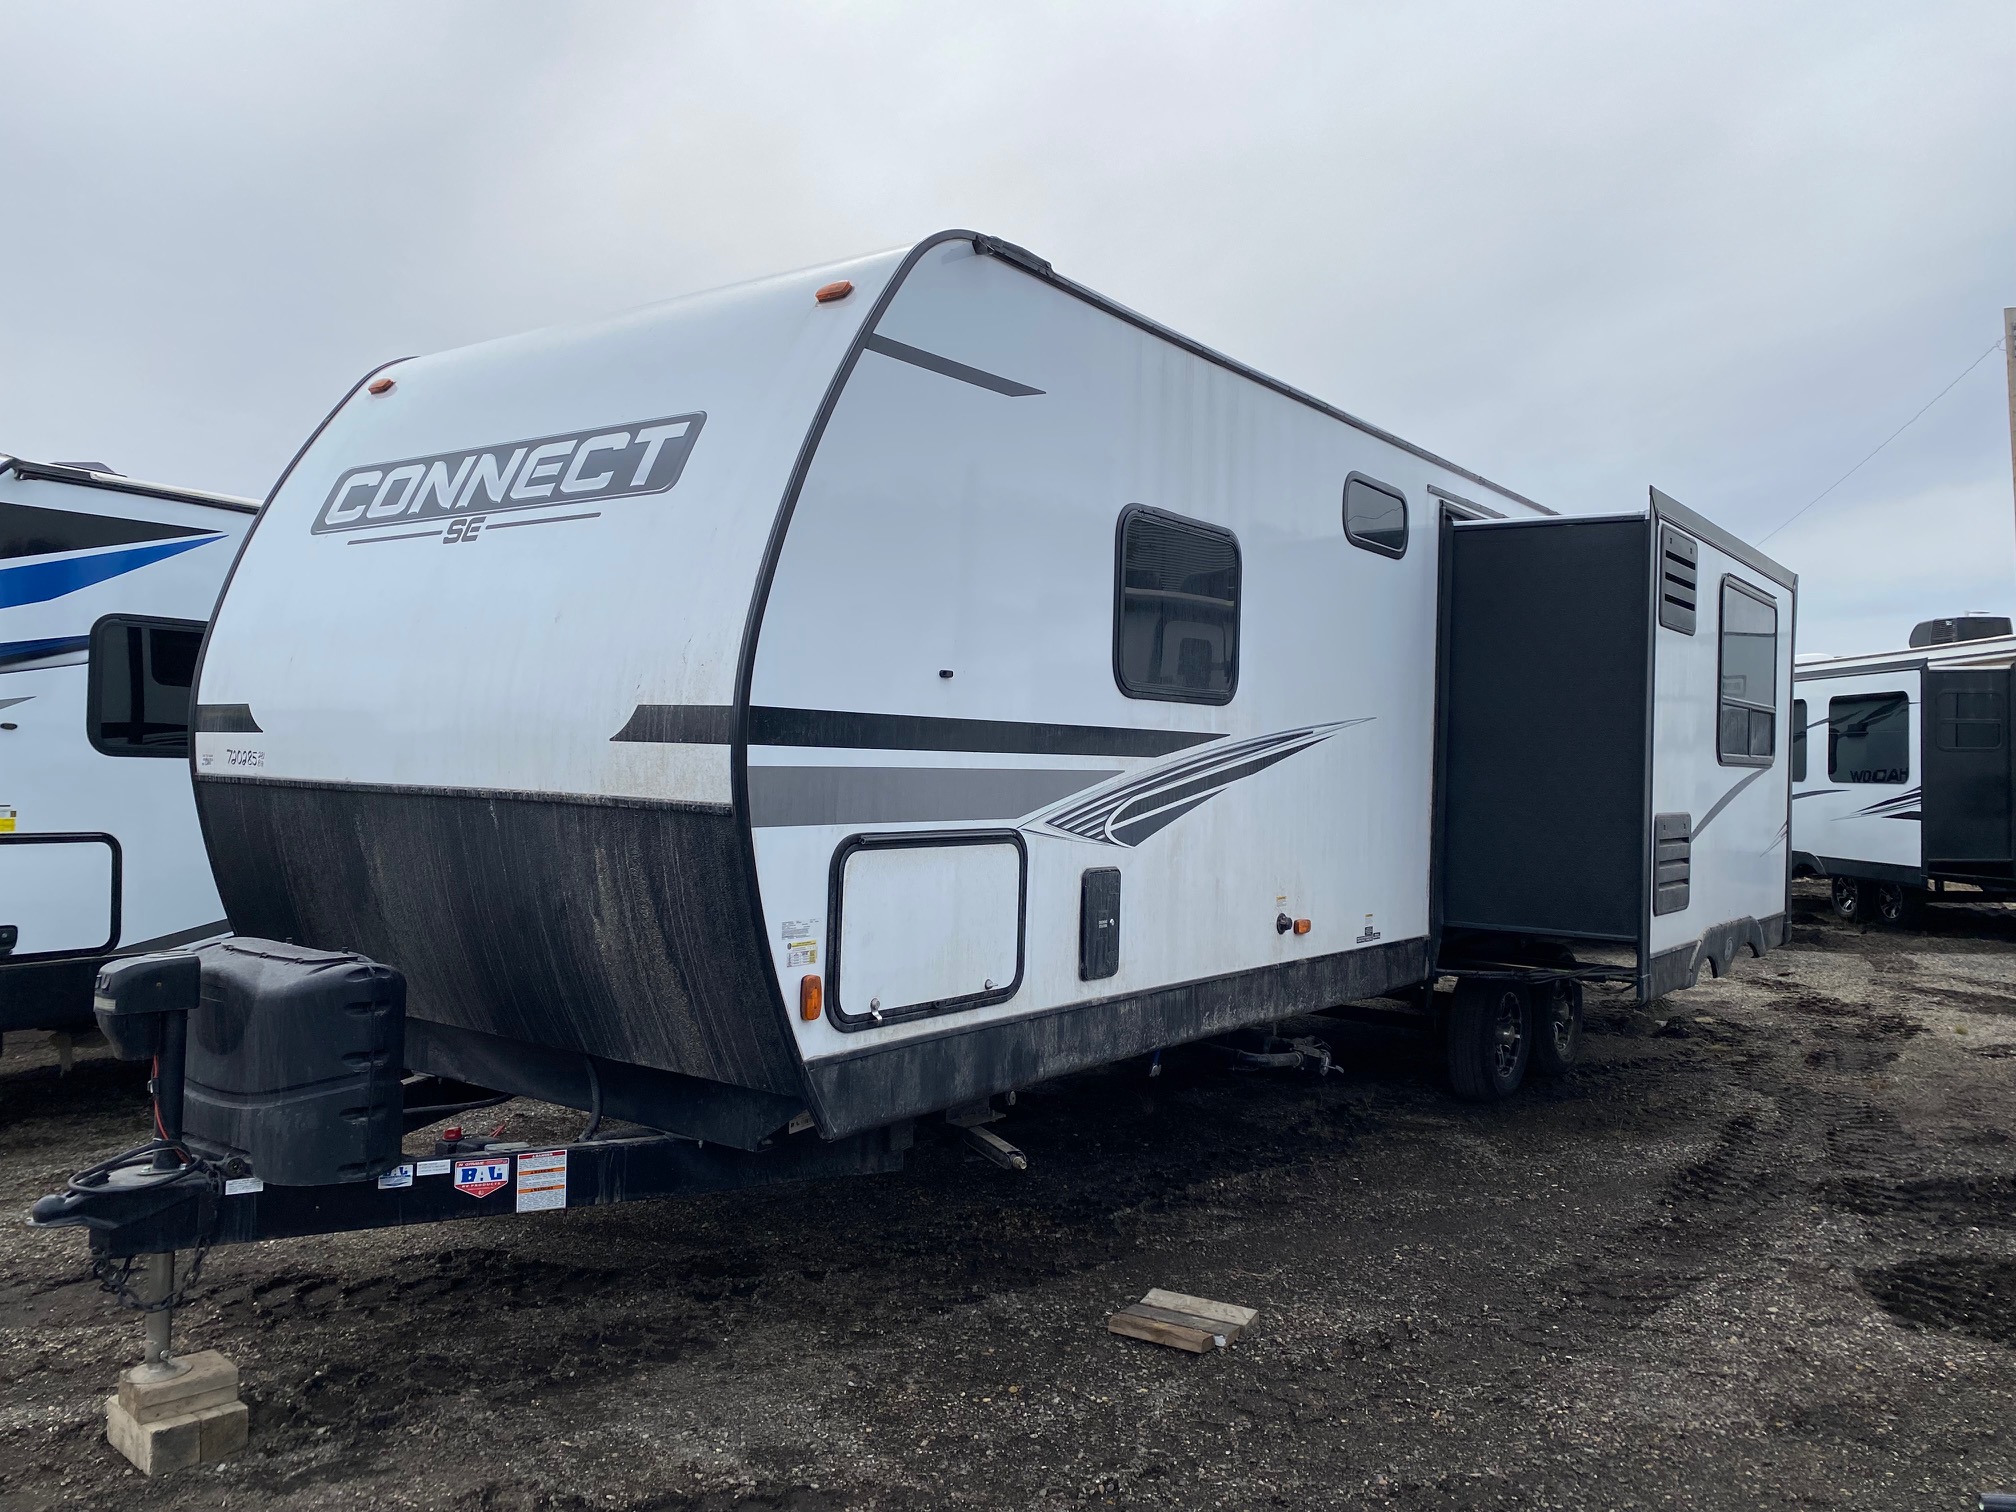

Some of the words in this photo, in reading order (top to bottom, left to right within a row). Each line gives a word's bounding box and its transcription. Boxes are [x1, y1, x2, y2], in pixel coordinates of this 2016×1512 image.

[325, 421, 691, 525] CONNECT
[442, 516, 487, 544] SE
[461, 1166, 503, 1183] BAL
